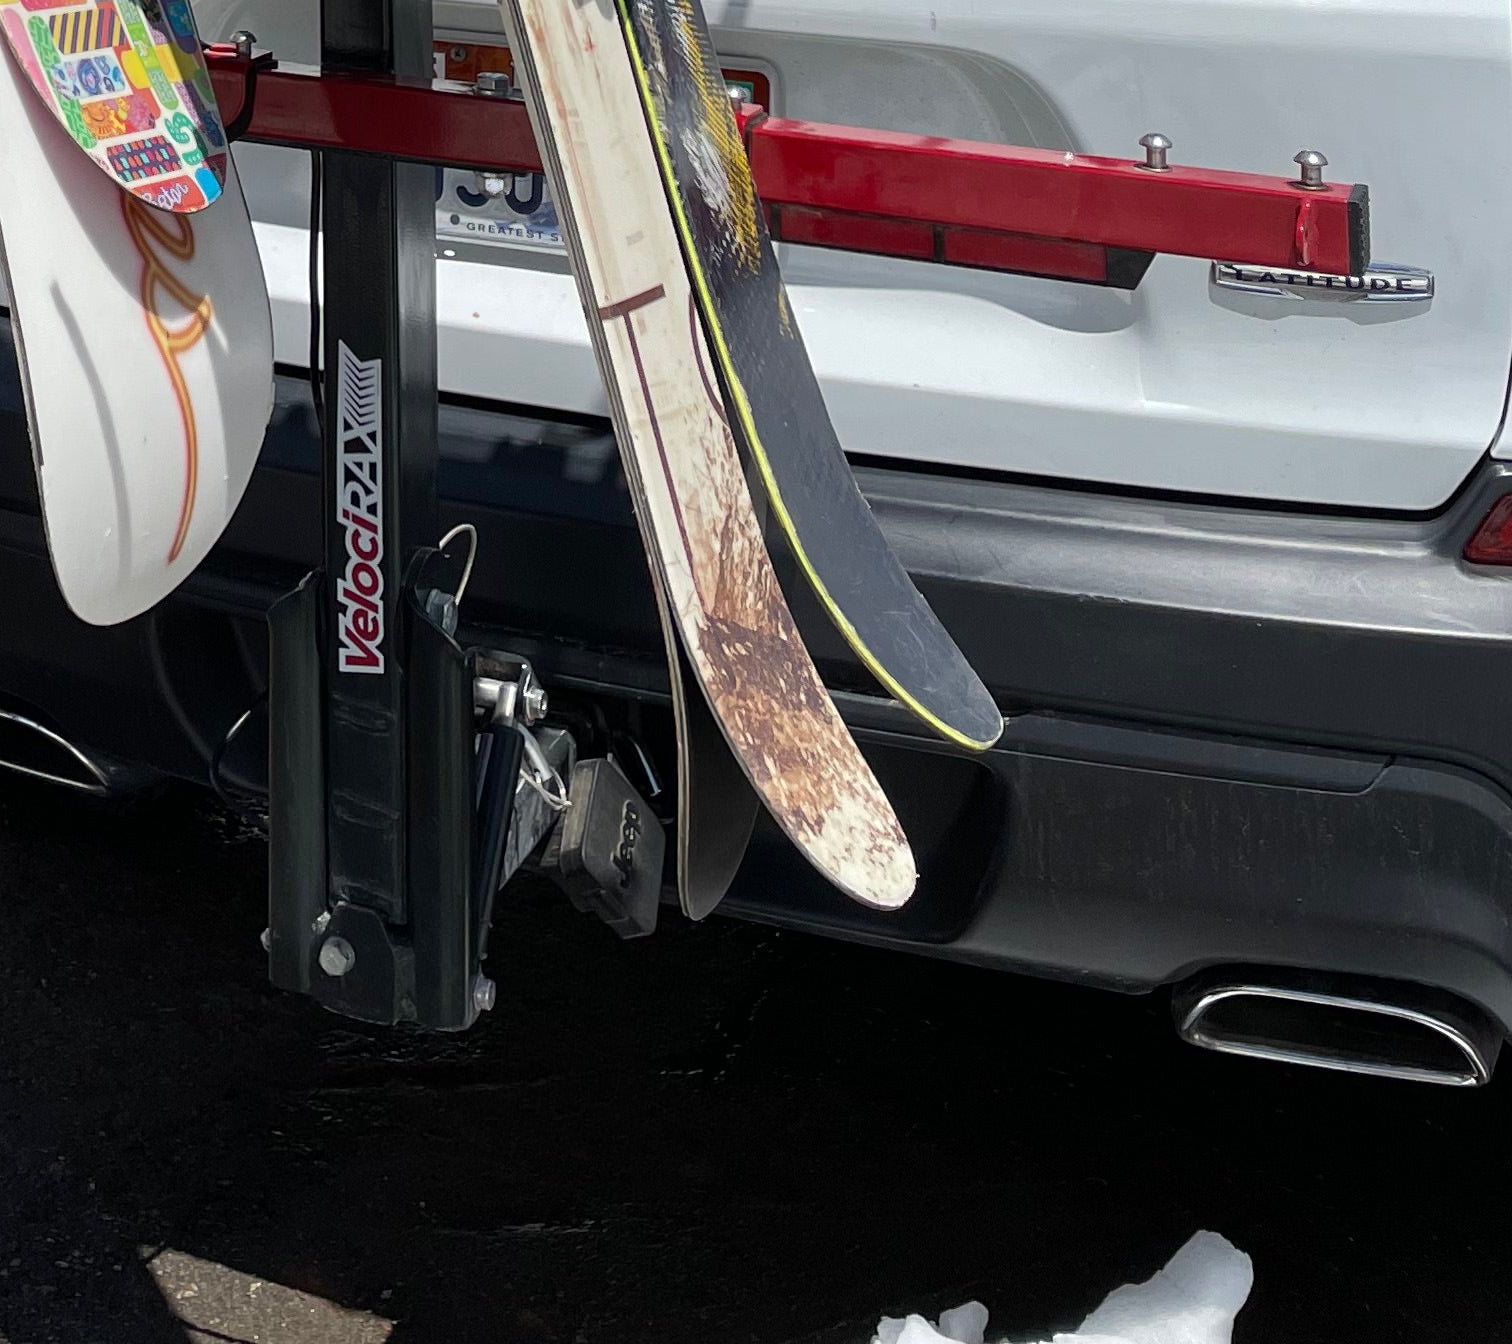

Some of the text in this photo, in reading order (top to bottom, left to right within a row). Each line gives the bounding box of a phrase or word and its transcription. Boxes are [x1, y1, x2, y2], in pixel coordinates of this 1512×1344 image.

[466, 221, 544, 241] GREATEST
[1223, 263, 1416, 290] LATITUDE
[341, 372, 379, 668] VelociRAX
